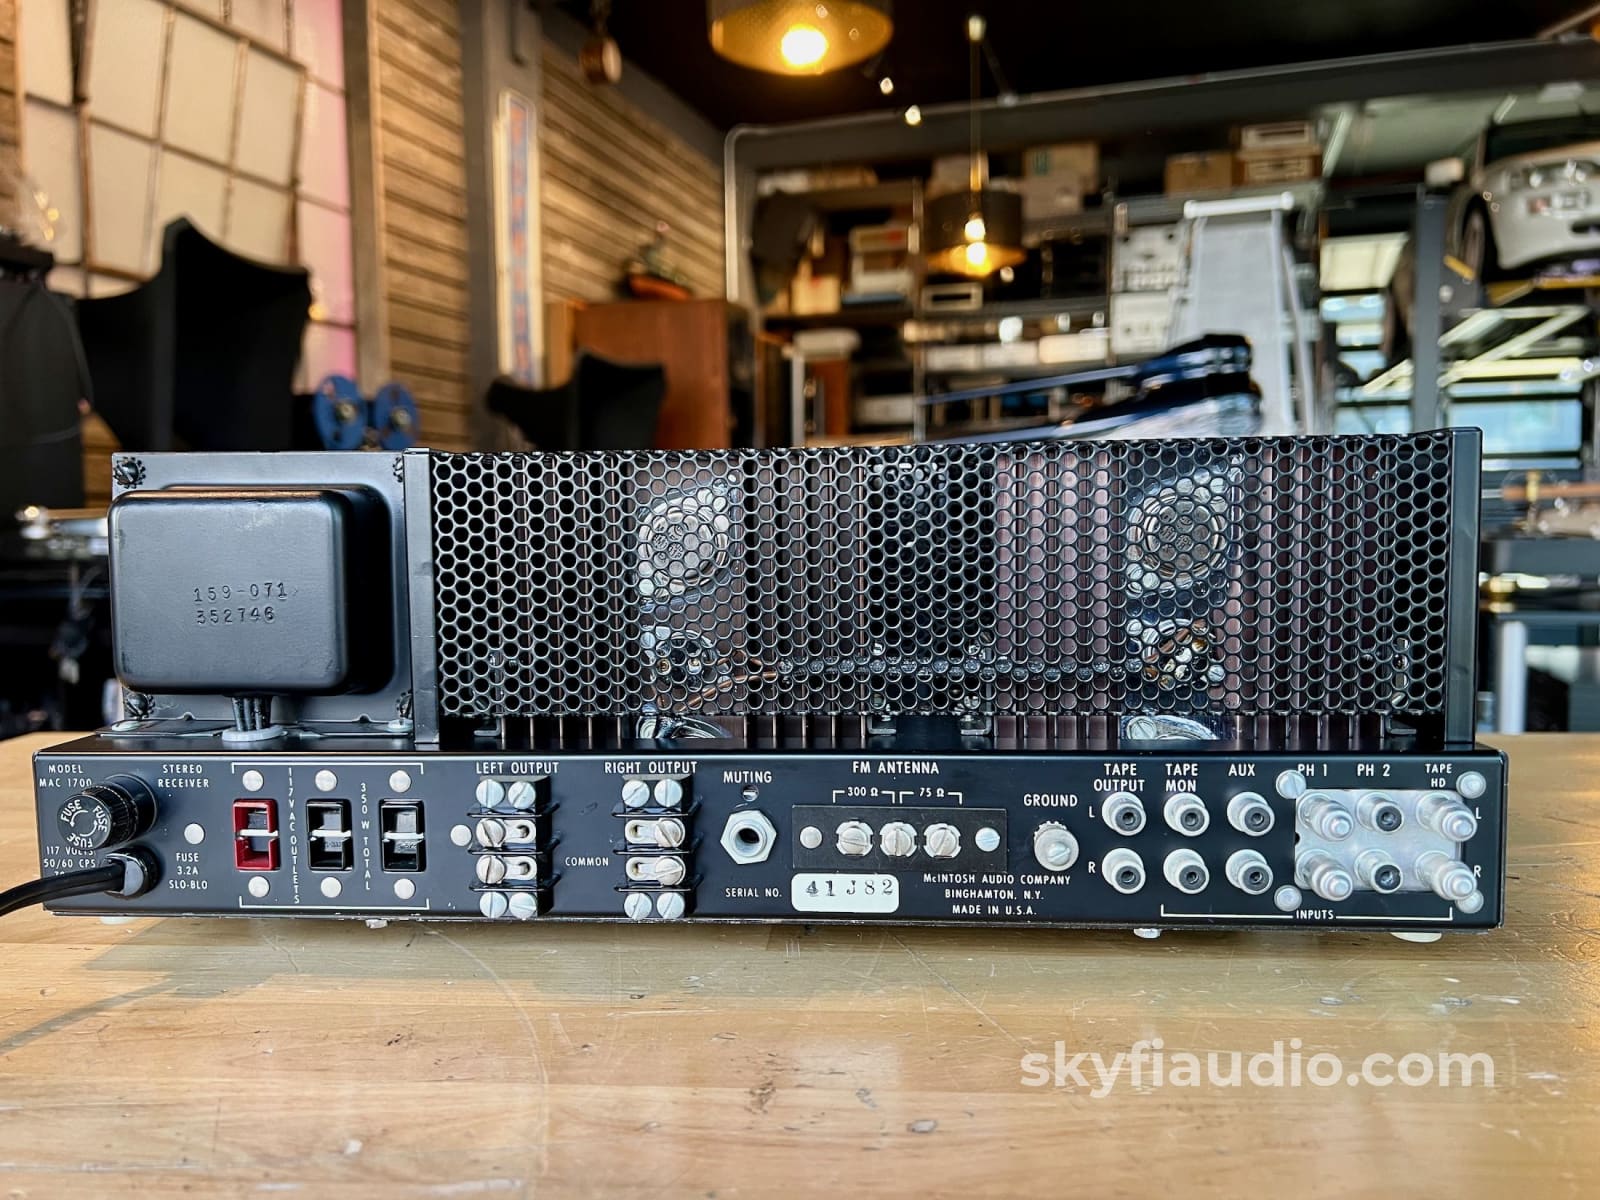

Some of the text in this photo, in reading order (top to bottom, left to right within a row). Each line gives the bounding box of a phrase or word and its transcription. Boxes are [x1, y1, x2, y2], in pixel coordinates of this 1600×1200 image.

[194, 582, 287, 602] 159-071
[196, 606, 274, 624] 352746
[48, 764, 84, 774] MODEL
[162, 764, 203, 774] STEREO
[476, 762, 559, 774] LEFT OUTPUT
[604, 762, 698, 774] RIGHT OUTPUT
[852, 761, 940, 774] FM ANTENNA
[1104, 764, 1138, 776] TAPE
[1165, 764, 1199, 776] TAPE
[1228, 764, 1256, 776] AUX
[1298, 764, 1328, 776] PH 1
[1357, 764, 1391, 777] PH 2
[1425, 764, 1453, 774] TAPE
[39, 778, 92, 788] MAC 1700
[158, 778, 209, 788] RECEIVER
[723, 771, 773, 784] MUTING
[1431, 778, 1446, 788] HD
[1093, 779, 1146, 792] OUTPUT
[1165, 780, 1197, 792] MON
[848, 787, 867, 797] 300
[920, 788, 932, 798] 75
[1023, 794, 1079, 808] GROUND
[60, 800, 82, 822] FUSE
[1088, 806, 1096, 818] L
[1475, 807, 1482, 820] L
[92, 805, 108, 832] FUSE
[66, 832, 93, 848] FUSE
[46, 846, 60, 855] 117
[176, 852, 199, 862] FUSE
[565, 856, 609, 867] COMMON
[44, 858, 96, 869] 50/60 CPS
[363, 837, 371, 890] TOTAL
[1088, 861, 1096, 874] R
[177, 866, 198, 876] 3.2A
[290, 836, 300, 904] OUTLETS
[1474, 864, 1482, 877] R
[169, 880, 208, 890] SLO-BLO
[982, 874, 1014, 884] AUDIO
[1020, 874, 1071, 886] COMPANY
[725, 887, 782, 898] SERIAL NO.
[1024, 890, 1044, 900] N.Y.
[952, 905, 1037, 916] MADE IN U.S.A.
[1296, 909, 1334, 920] INPUTS
